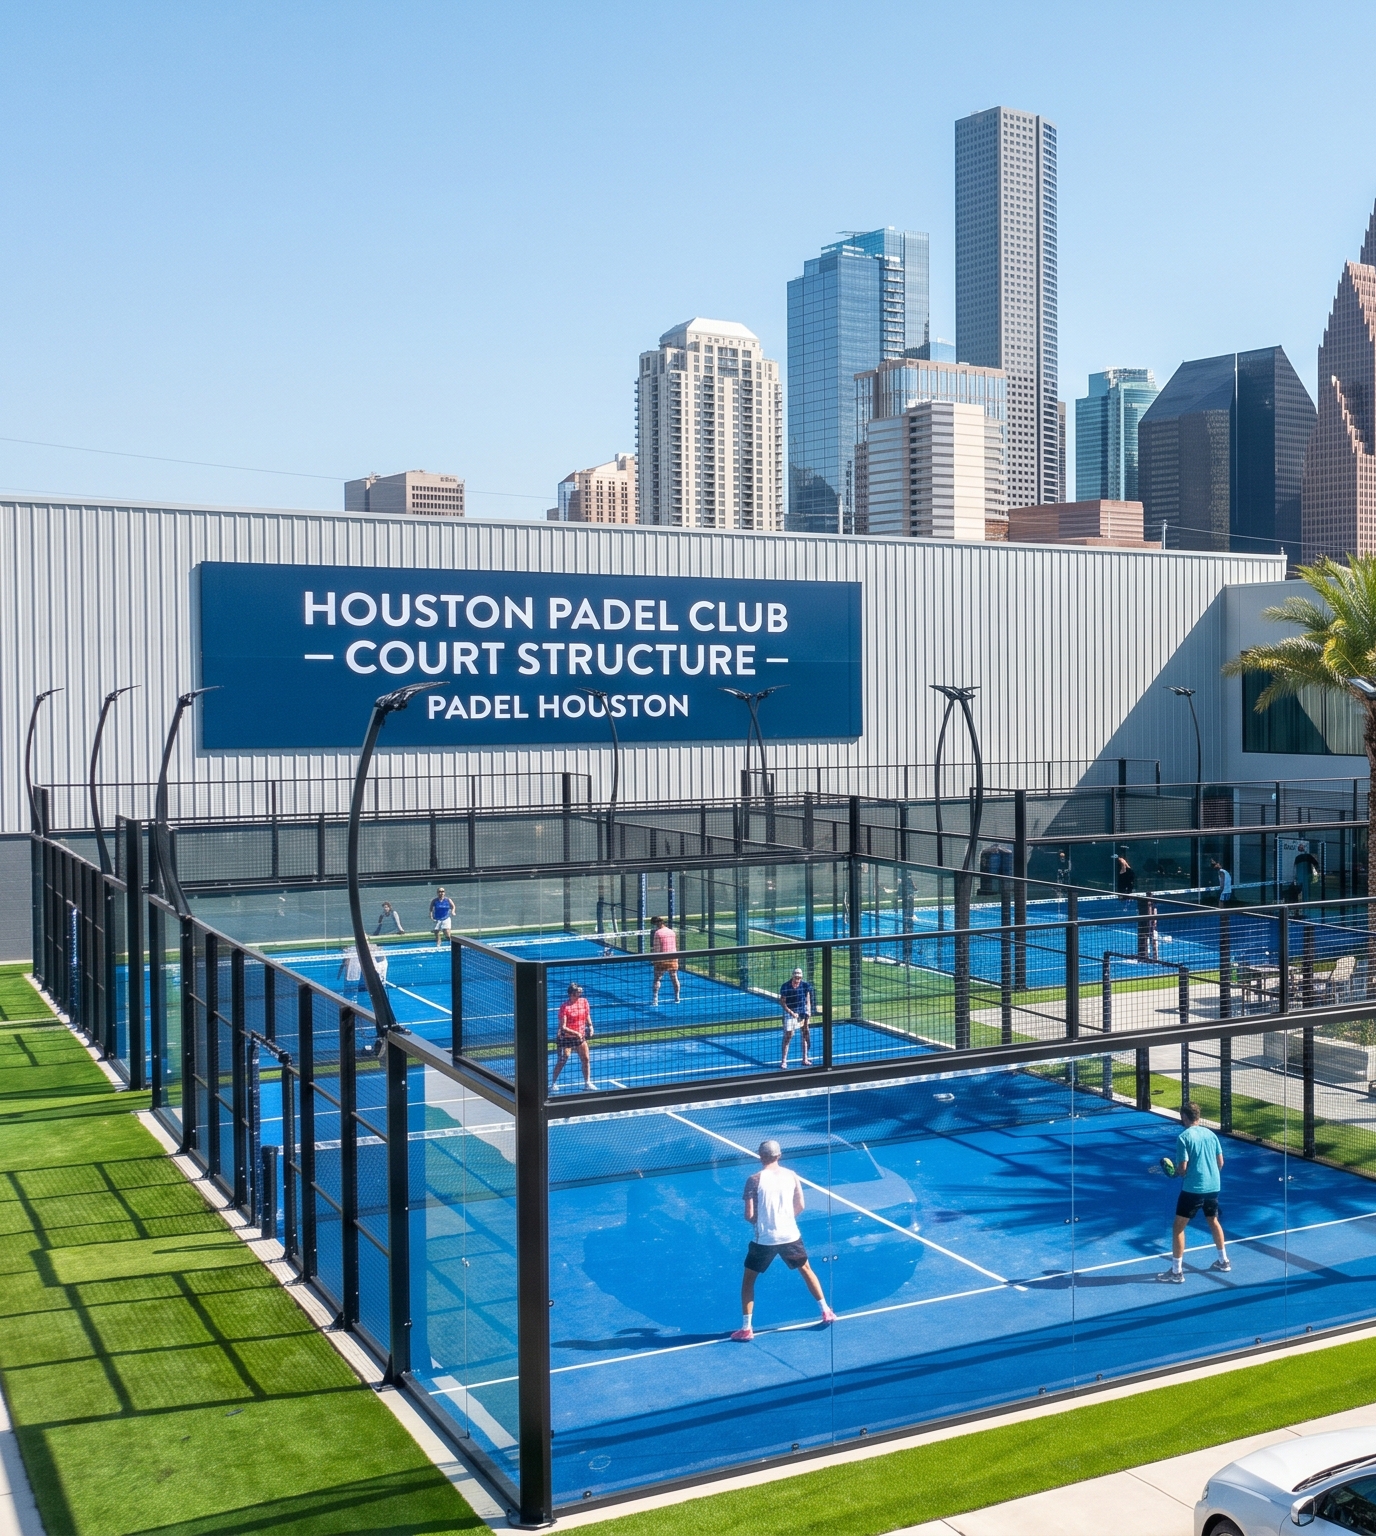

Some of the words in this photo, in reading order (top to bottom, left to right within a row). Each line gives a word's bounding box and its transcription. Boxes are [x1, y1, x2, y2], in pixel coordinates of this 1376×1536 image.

[304, 591, 533, 630] HOUSTON
[549, 597, 679, 632] PADEL
[688, 600, 788, 633] CLUB
[345, 639, 505, 675] COURT
[517, 642, 756, 676] STRUCTURE
[428, 695, 529, 720] PADEL
[539, 694, 689, 719] HOUSTON
